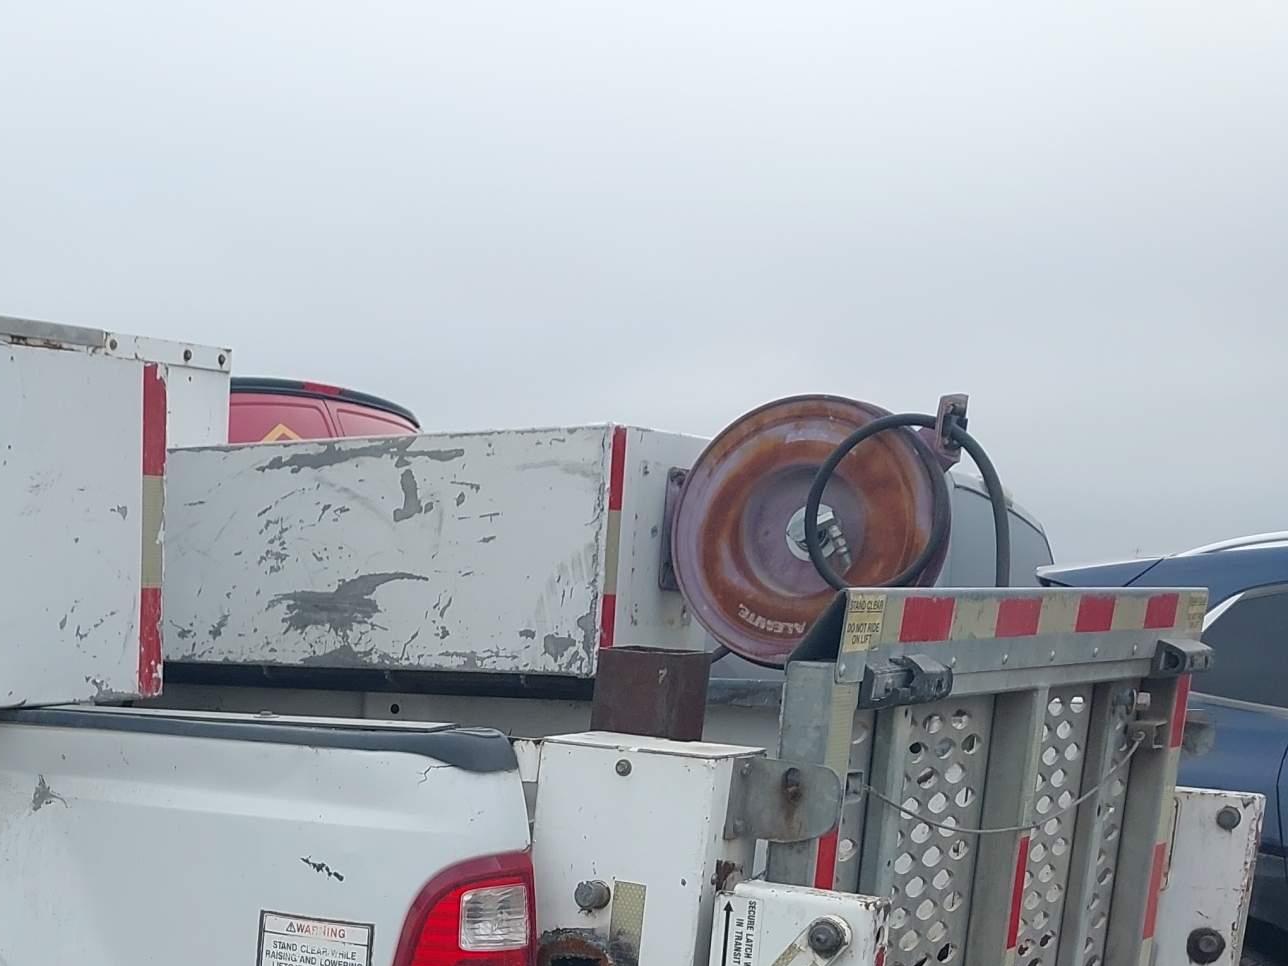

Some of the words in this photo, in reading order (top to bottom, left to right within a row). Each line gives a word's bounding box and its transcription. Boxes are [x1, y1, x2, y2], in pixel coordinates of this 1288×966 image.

[735, 918, 745, 927] IN
[746, 900, 757, 931] SECURE
[272, 940, 298, 952] STAND
[732, 931, 743, 965] TRANSIT
[743, 934, 754, 959] LATCH
[265, 949, 297, 962] RAISING
[299, 955, 317, 966] AND
